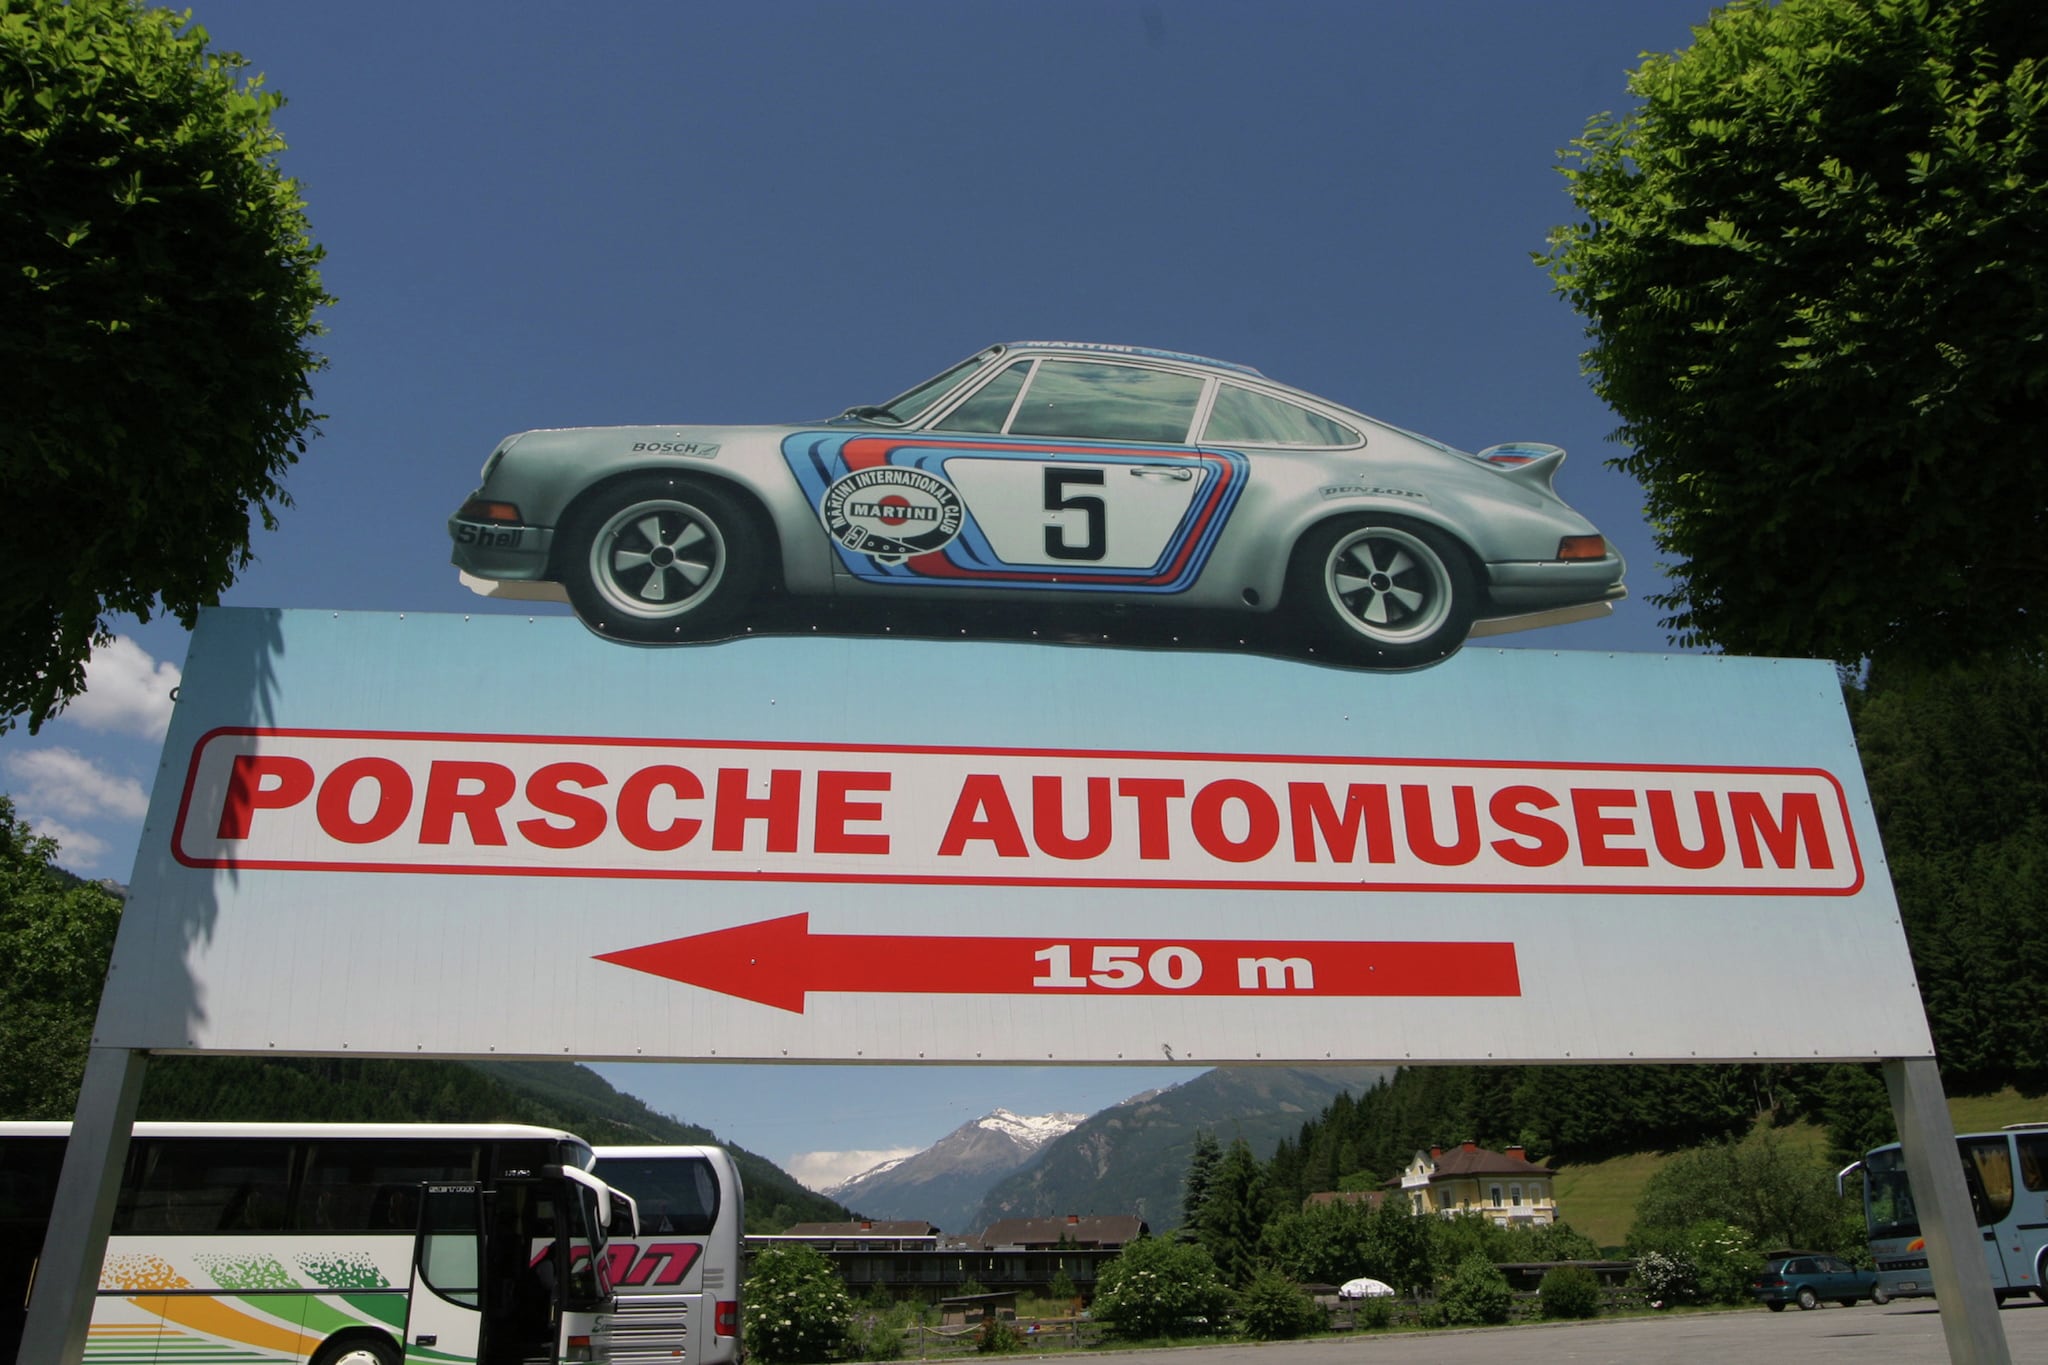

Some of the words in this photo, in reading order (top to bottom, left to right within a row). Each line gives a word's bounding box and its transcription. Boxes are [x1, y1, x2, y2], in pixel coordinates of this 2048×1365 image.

[1027, 340, 1132, 352] MARTINI
[632, 442, 698, 453] BOSCH
[828, 479, 857, 529] MARTINI
[856, 470, 952, 504] INTERNATIONAL
[939, 504, 960, 535] CLUB
[1325, 486, 1424, 498] DUNLOP
[853, 503, 934, 520] MARTINI
[1043, 466, 1107, 561] 5
[456, 524, 524, 547] Shell
[216, 754, 892, 855] PORSCHE
[937, 774, 1834, 870] AUTOMUSEUM
[1031, 945, 1202, 990] 150
[1237, 956, 1314, 990] m
